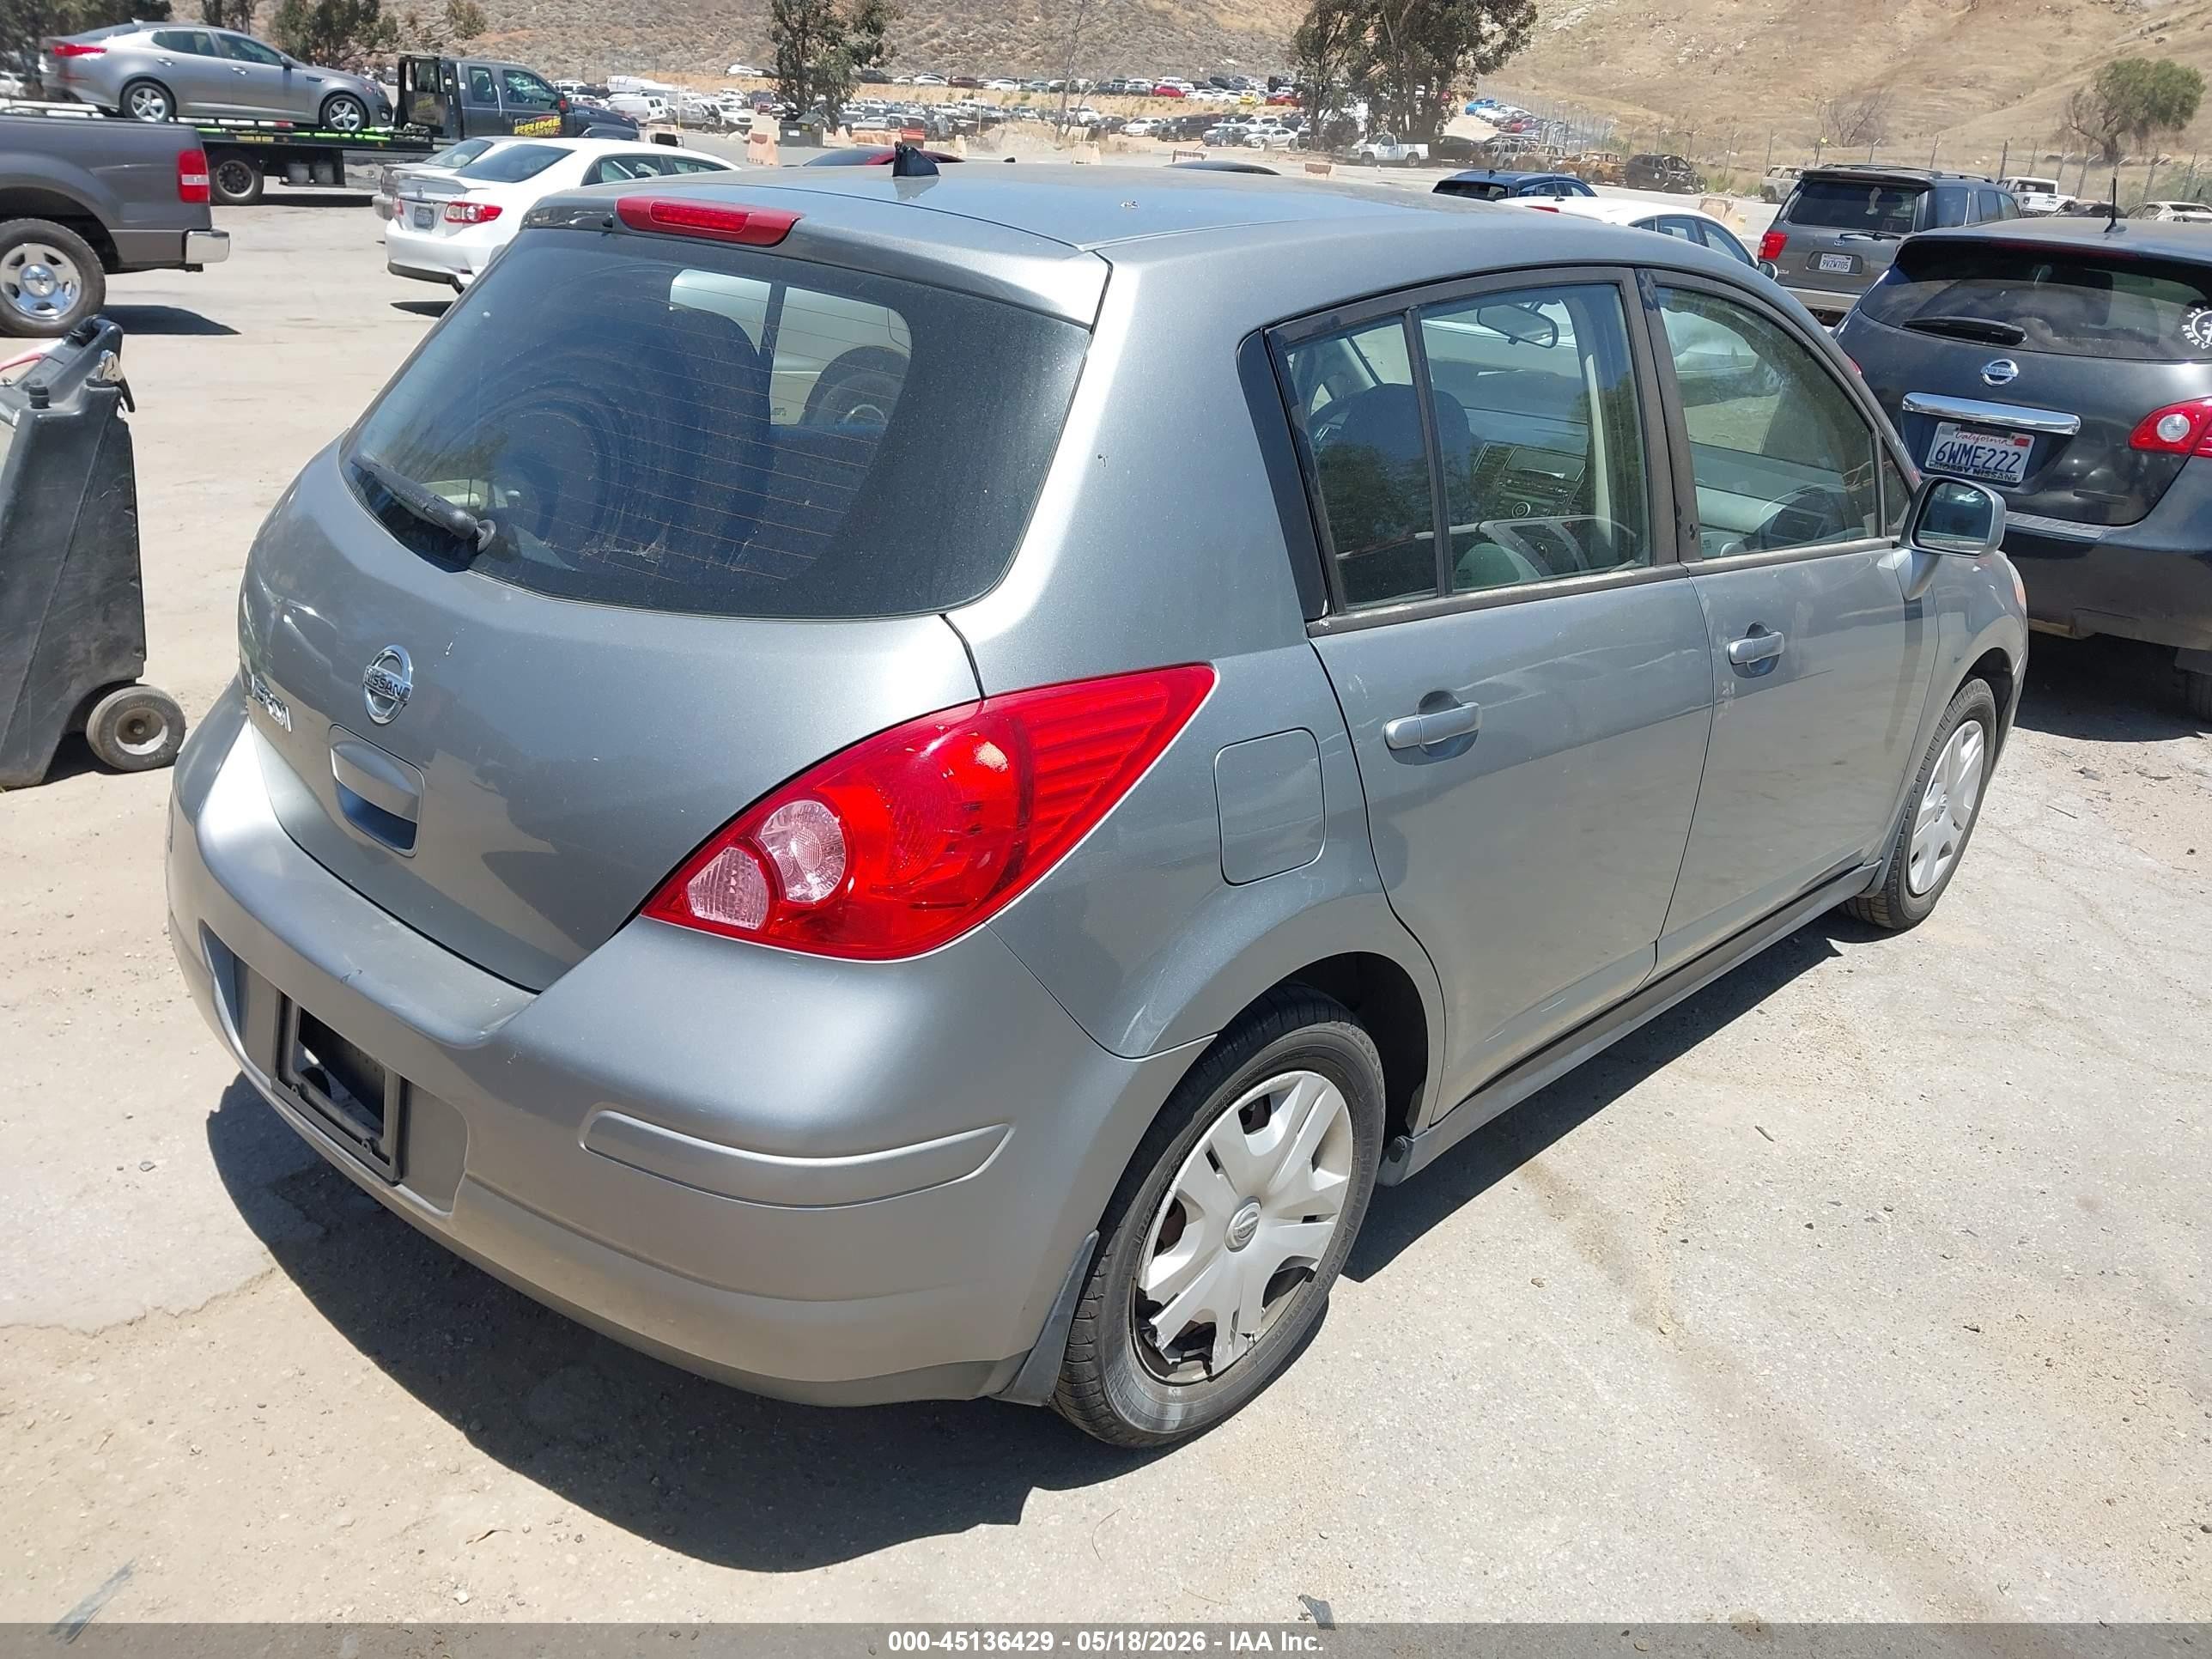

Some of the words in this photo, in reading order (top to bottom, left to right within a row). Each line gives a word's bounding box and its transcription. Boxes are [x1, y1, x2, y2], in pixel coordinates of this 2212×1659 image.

[514, 115, 561, 135] PRIME
[1821, 259, 1849, 270] 9VZW705
[2182, 325, 2209, 349] KRAV
[1955, 431, 2013, 446] California
[1936, 441, 2021, 474] 6WME222
[1972, 468, 2013, 481] NISSAN
[366, 668, 404, 697] NISSAN
